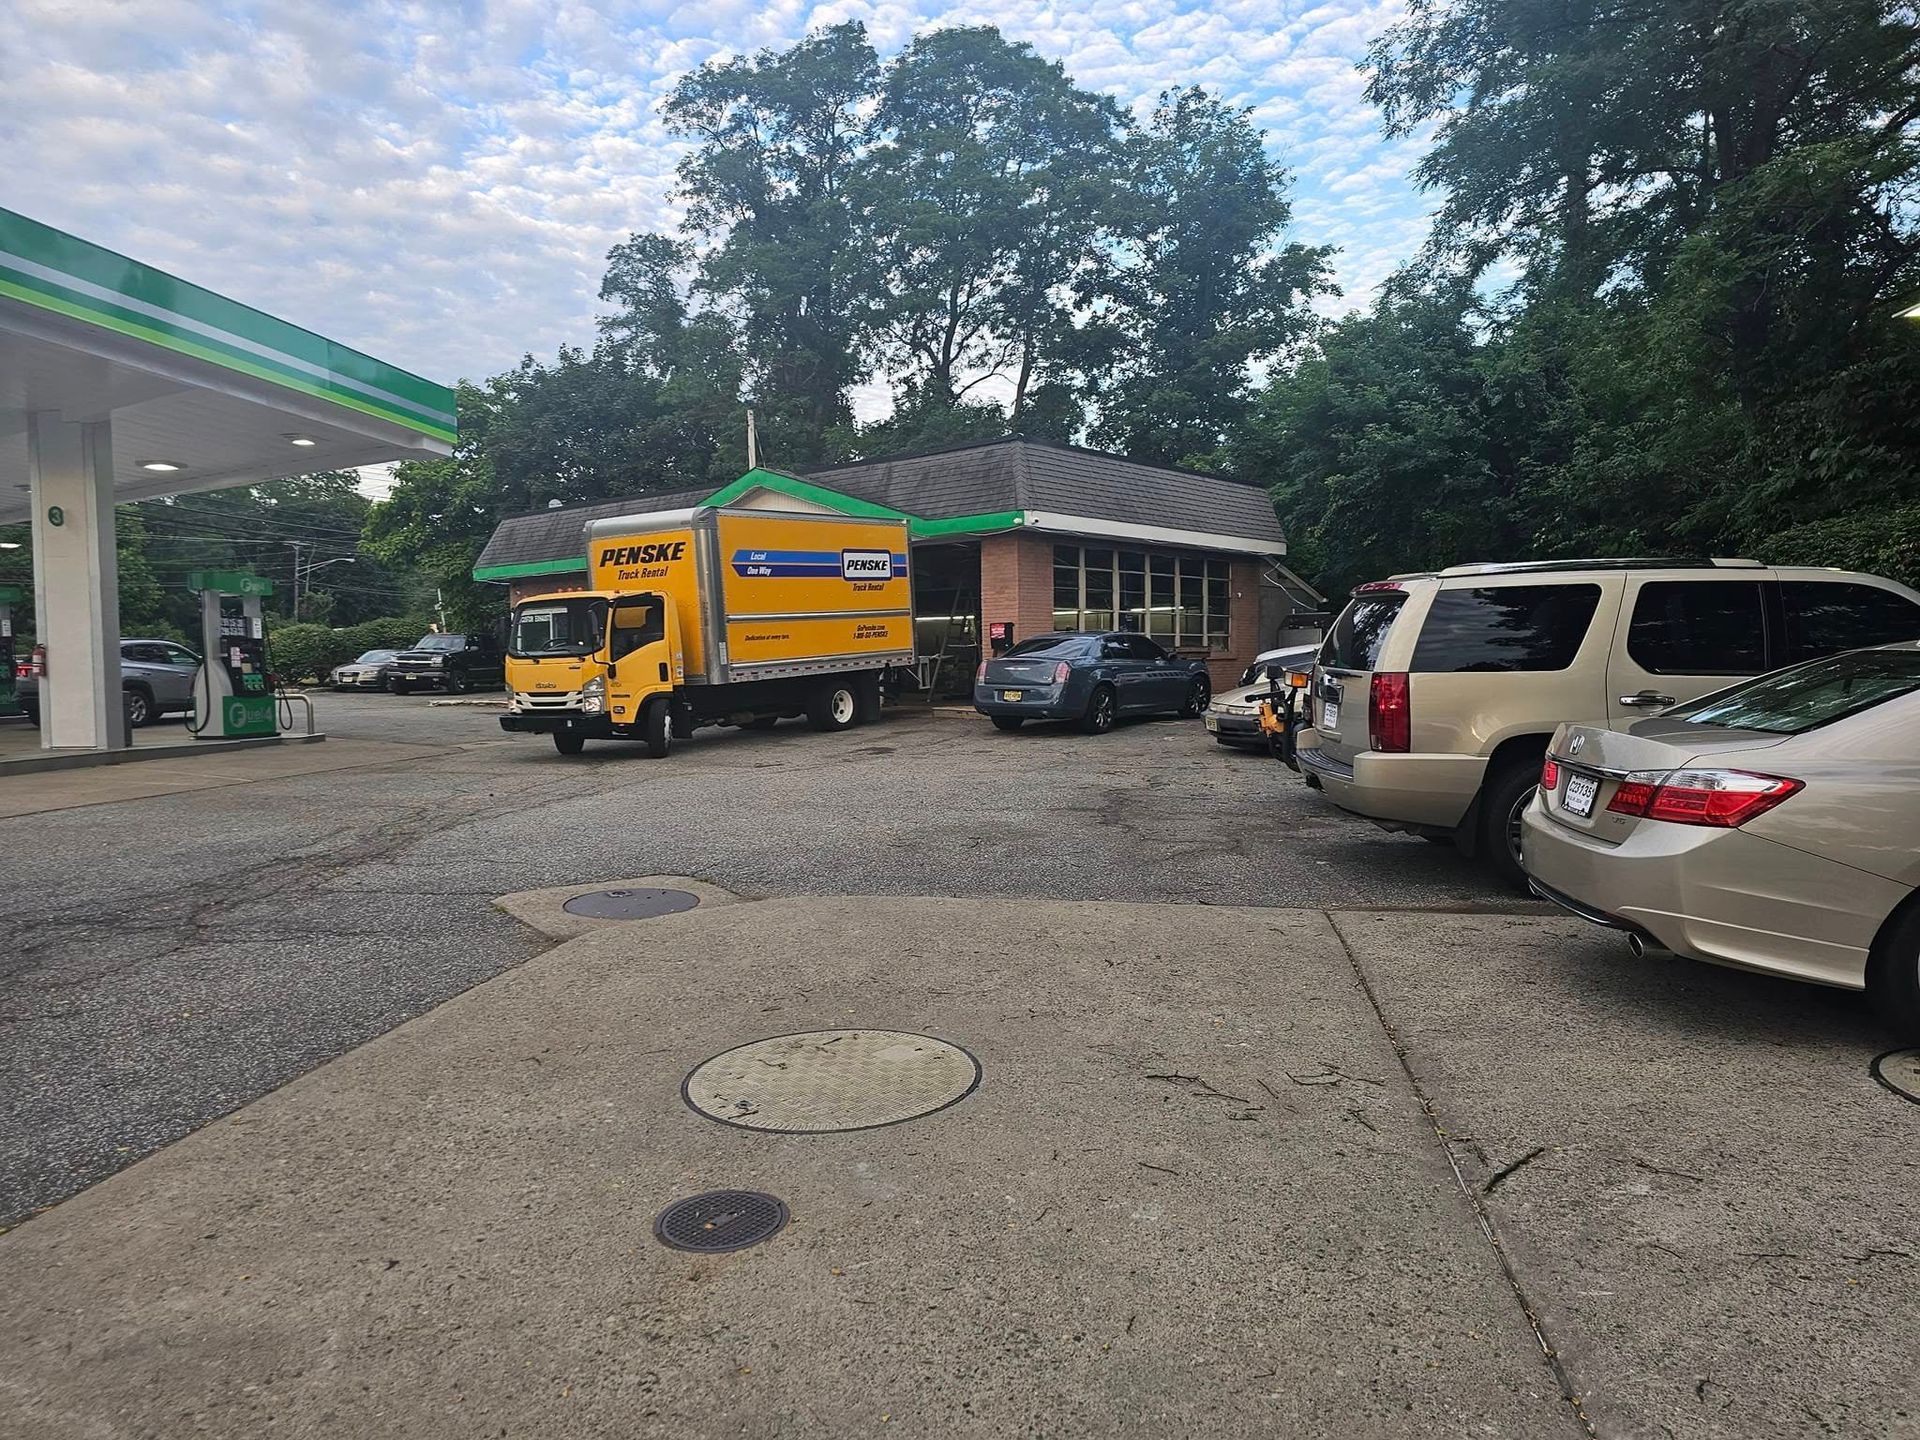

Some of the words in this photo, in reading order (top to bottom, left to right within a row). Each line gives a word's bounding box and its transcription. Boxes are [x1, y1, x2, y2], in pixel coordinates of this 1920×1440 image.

[599, 542, 686, 567] PENSKE
[750, 552, 767, 560] Local
[847, 560, 888, 570] PENSKE
[618, 569, 639, 580] Truck
[641, 566, 668, 579] Rental
[747, 566, 758, 575] One
[760, 566, 772, 576] Way
[853, 583, 866, 591] Truck
[868, 583, 884, 591] Rental
